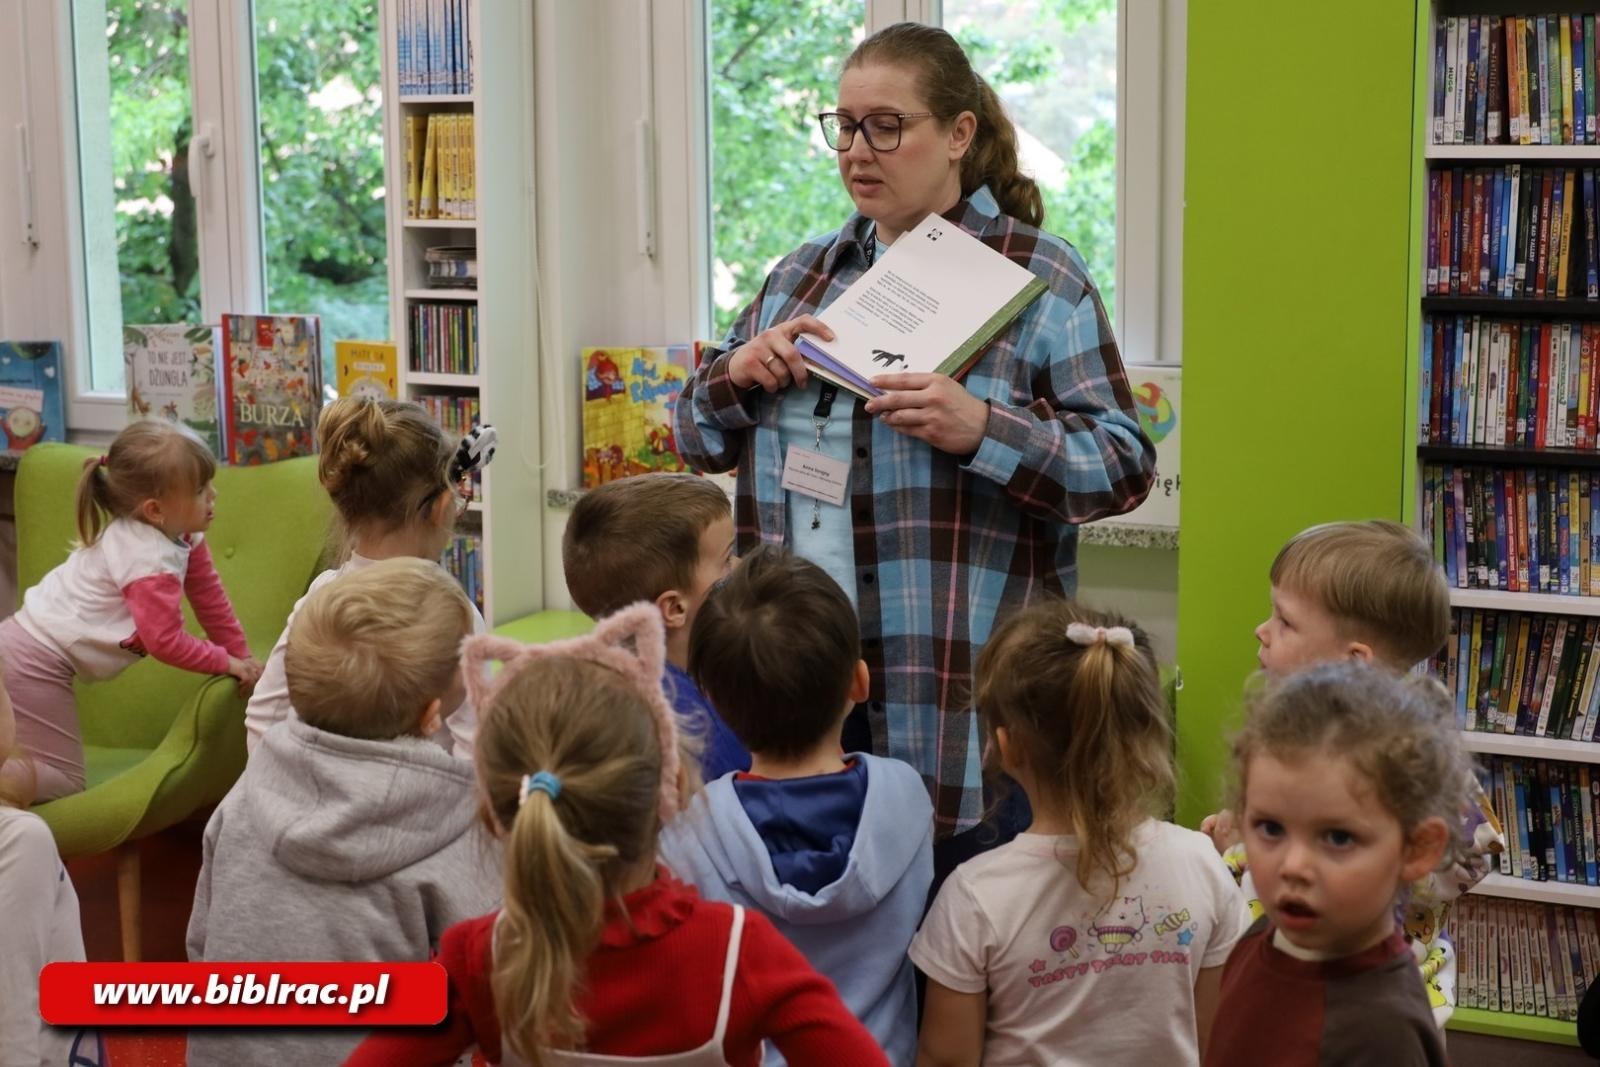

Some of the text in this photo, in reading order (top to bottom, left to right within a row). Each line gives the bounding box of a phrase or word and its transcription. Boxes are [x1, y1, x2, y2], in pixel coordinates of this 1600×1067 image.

[158, 350, 169, 365] NIE
[171, 351, 187, 365] JEST
[239, 403, 305, 428] BURZA
[1028, 962, 1090, 988] TASTY
